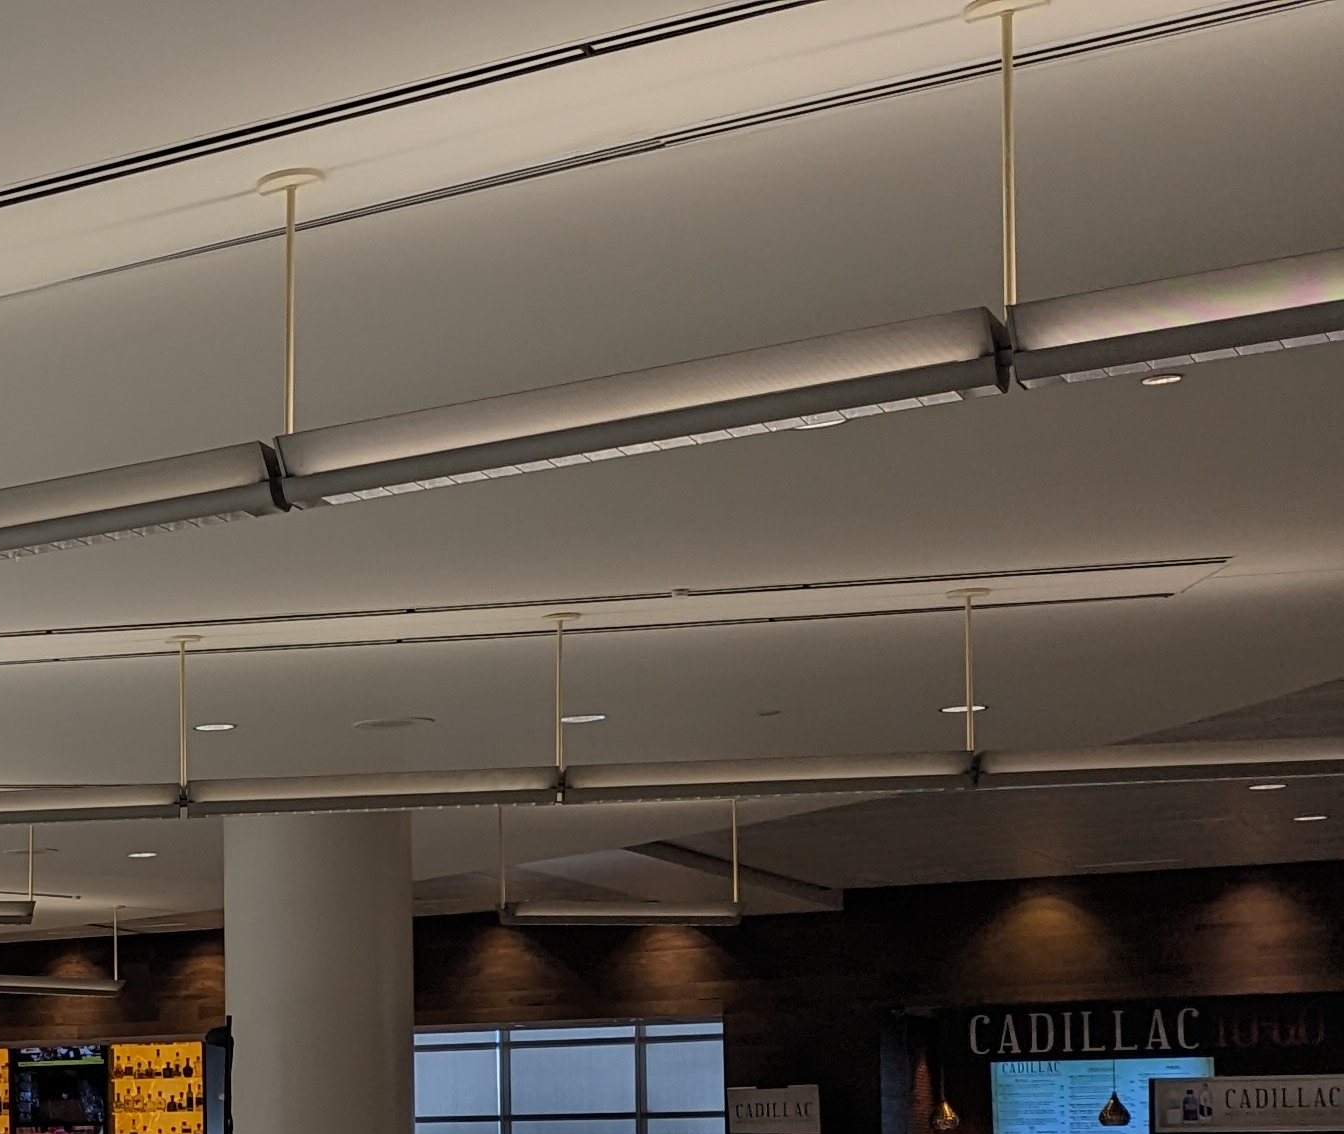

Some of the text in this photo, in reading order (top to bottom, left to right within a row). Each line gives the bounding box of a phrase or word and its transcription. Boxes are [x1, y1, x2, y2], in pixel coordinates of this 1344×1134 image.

[969, 1007, 1200, 1055] CADILLAC
[1002, 1061, 1062, 1075] CADILLAC
[1225, 1086, 1342, 1109] CADILLAC
[736, 1102, 812, 1119] CADILLAC
